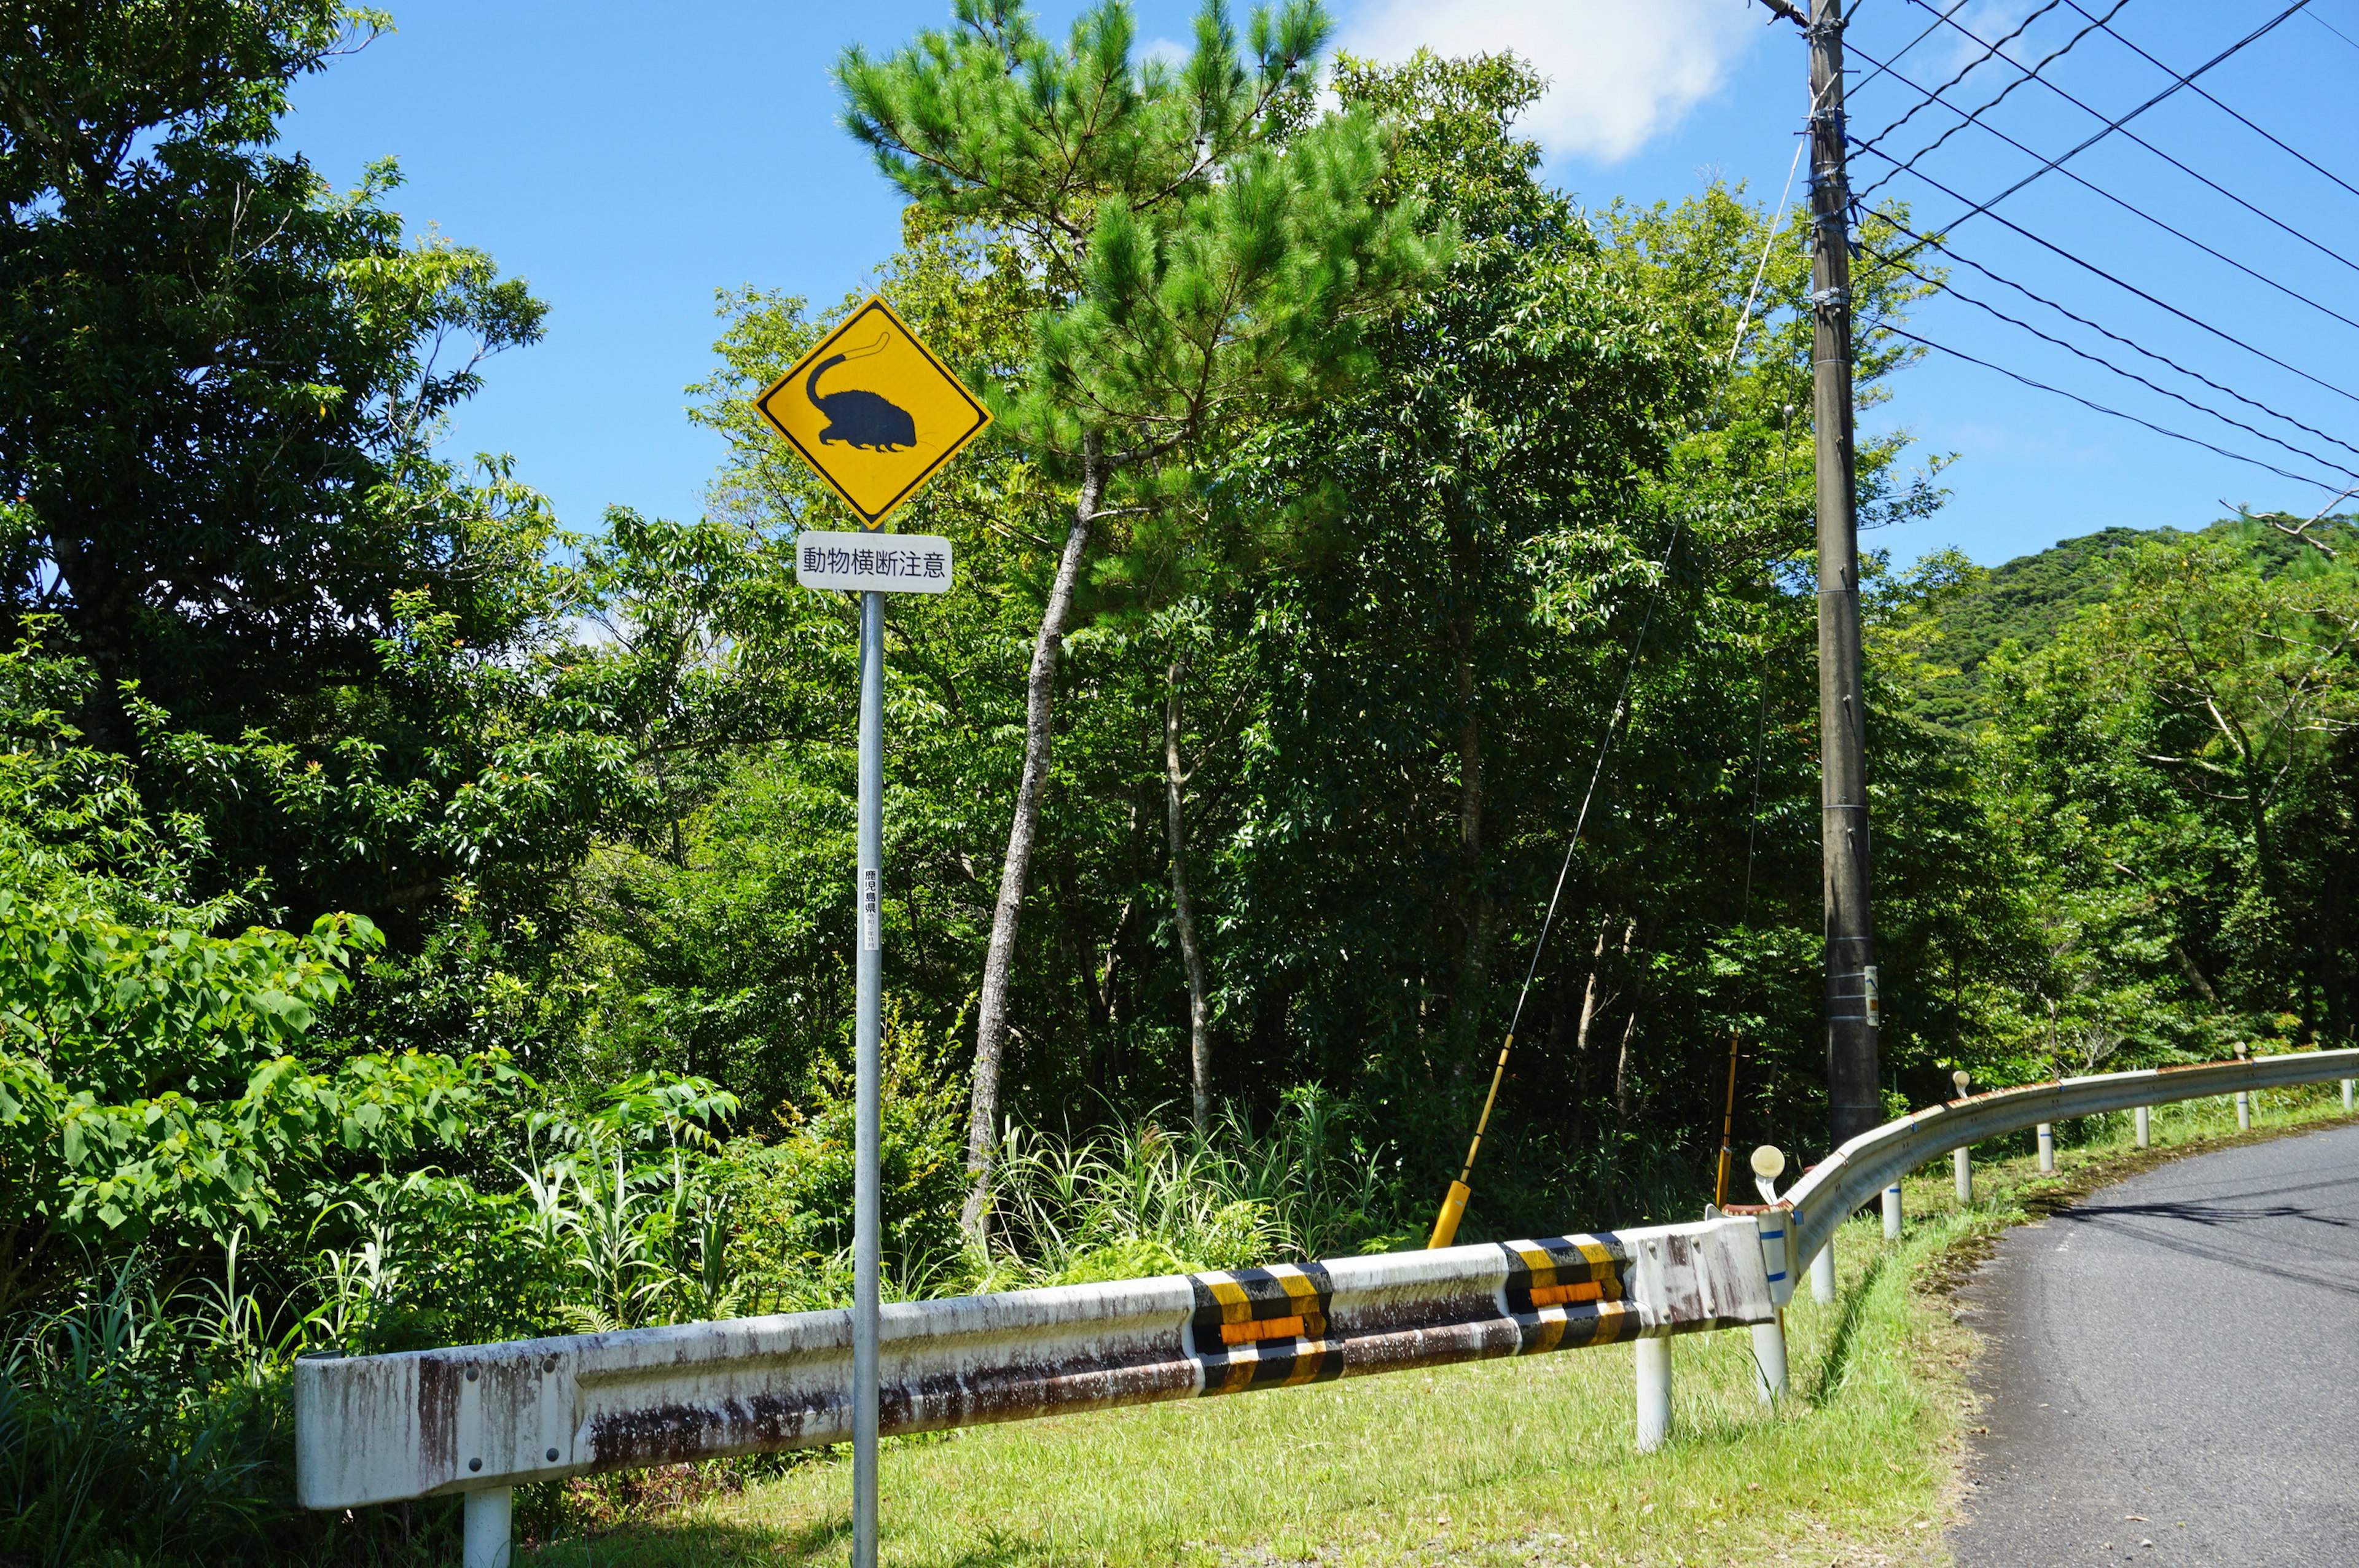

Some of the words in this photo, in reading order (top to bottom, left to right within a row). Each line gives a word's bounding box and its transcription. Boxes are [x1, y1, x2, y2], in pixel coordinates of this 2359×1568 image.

[803, 547, 945, 578] 動物横断注意
[865, 870, 876, 913] 鹿児島県
